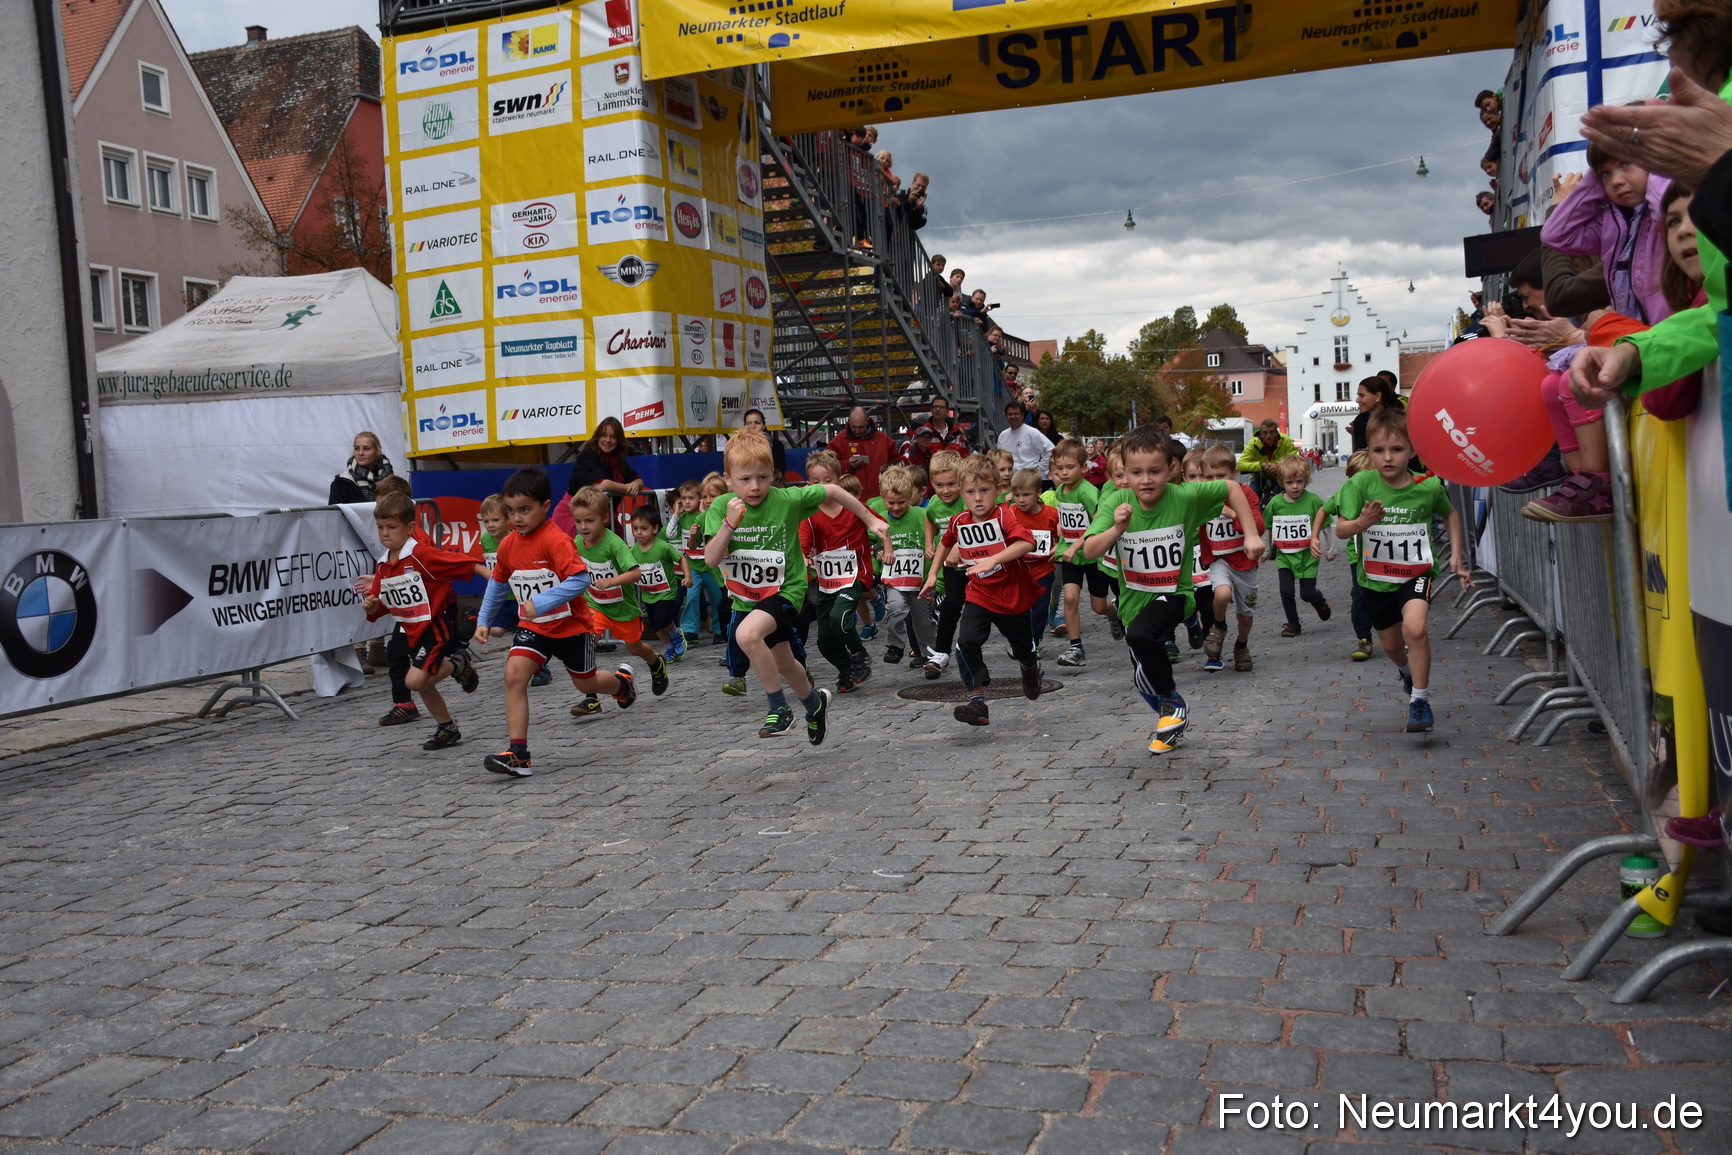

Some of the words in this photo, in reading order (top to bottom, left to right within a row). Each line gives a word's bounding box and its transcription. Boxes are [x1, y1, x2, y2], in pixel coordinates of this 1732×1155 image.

[678, 16, 771, 37] Neumarkter
[775, 0, 846, 26] Stadtlauf
[1301, 19, 1397, 40] Neumarkter
[1401, 2, 1480, 25] Stadtlauf
[533, 44, 556, 54] KANN
[996, 6, 1252, 89] START
[439, 64, 475, 77] energie
[603, 86, 645, 100] Neumarkter
[808, 82, 884, 102] Neumarkter
[888, 74, 952, 92] Stadtlauf
[426, 101, 450, 123] RUND
[492, 93, 542, 117] swn
[492, 112, 525, 124] stadtwerke
[526, 107, 556, 120] neumarkt
[424, 118, 455, 140] SCHAU
[588, 148, 646, 165] RAIL.ONE
[405, 179, 456, 196] RAIL.ONE
[512, 207, 547, 219] GERHART
[529, 213, 553, 223] JANIG
[634, 220, 665, 232] energie
[427, 232, 478, 250] VARIOTEC
[527, 236, 546, 246] KIA
[620, 267, 643, 277] MINI
[539, 292, 578, 304] energie
[505, 338, 544, 354] Neumarkter
[545, 338, 574, 350] Tagblatt
[416, 359, 463, 374] RAIL.ONE
[97, 363, 293, 400] ww.jura-gebaeudeservice.de
[721, 396, 739, 409] swn
[1320, 405, 1343, 414] BMW
[522, 404, 582, 419] VARIOTEC
[634, 407, 656, 421] DEHN
[452, 427, 485, 438] energie
[1457, 452, 1488, 478] energie
[958, 522, 997, 546] 000
[1138, 534, 1174, 544] Neumarkt
[1275, 524, 1308, 539] 7156
[967, 549, 989, 558] Lukas
[1123, 542, 1182, 570] 7106
[1368, 538, 1423, 562] 7111
[740, 556, 773, 564] Neumarkt
[3, 553, 88, 599] BMW
[724, 562, 779, 585] 7039
[817, 560, 854, 578] 7014
[1382, 565, 1412, 576] Simon
[208, 558, 272, 597] BMW
[388, 578, 412, 589] Neumarkt
[825, 580, 842, 588] Elias
[1135, 574, 1178, 586] Johannes
[381, 584, 424, 606] 7058
[744, 588, 760, 599] Finn
[211, 598, 284, 627] WENIGER
